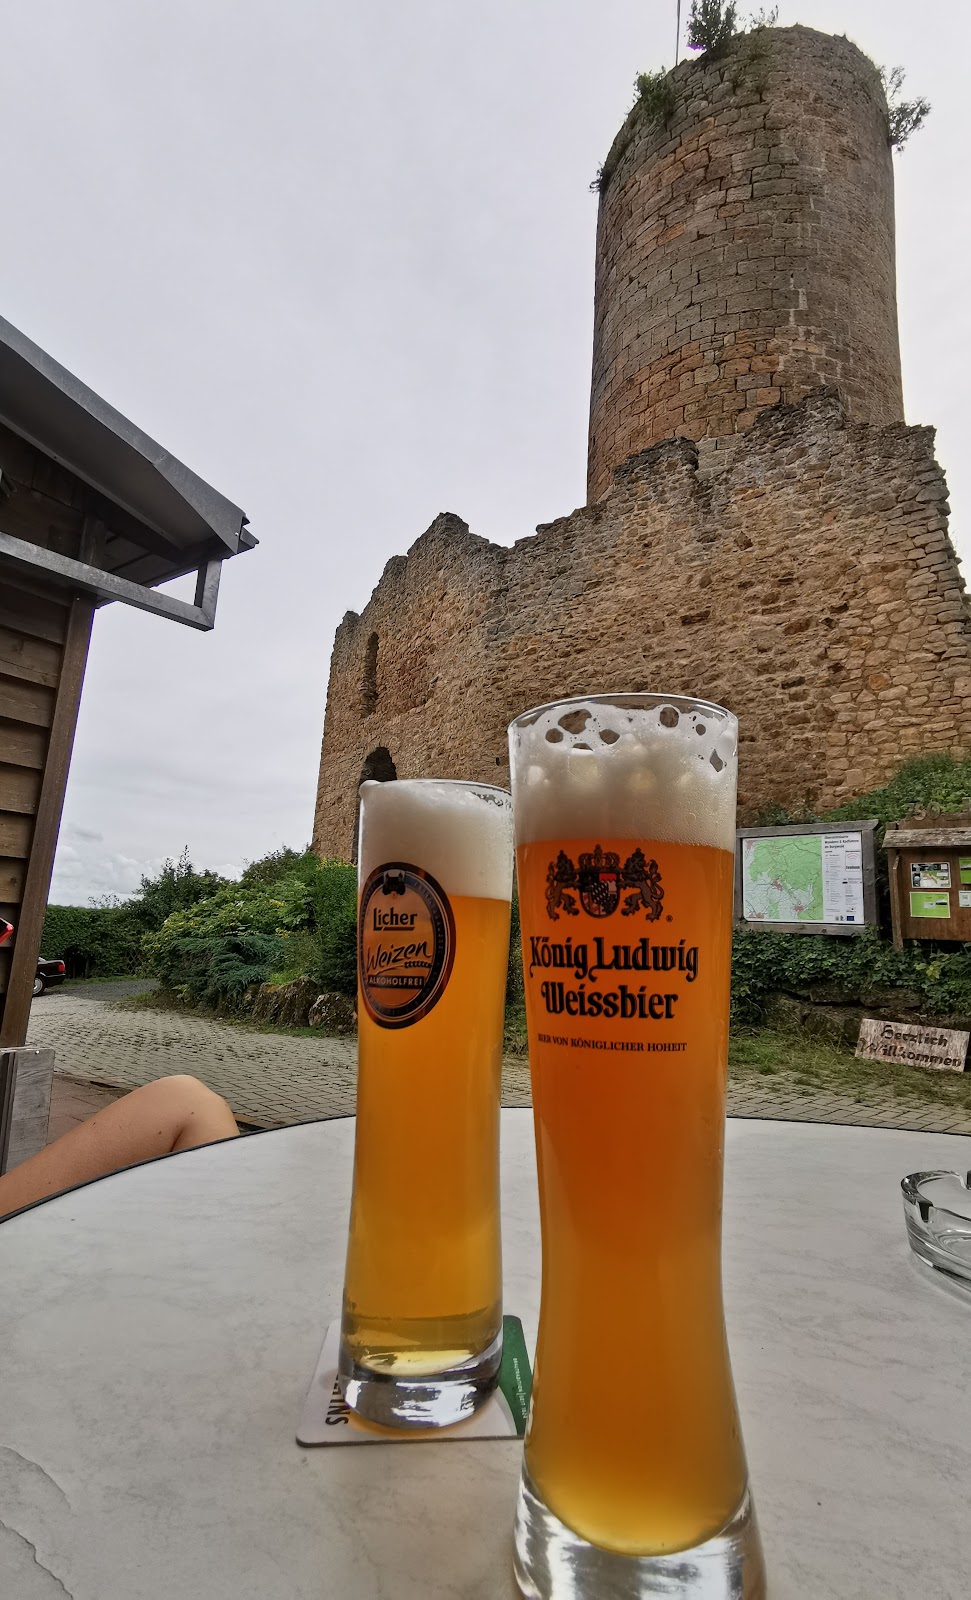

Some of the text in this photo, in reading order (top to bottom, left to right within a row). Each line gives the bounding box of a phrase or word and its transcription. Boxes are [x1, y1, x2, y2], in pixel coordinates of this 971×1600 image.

[373, 907, 417, 931] Licher
[366, 941, 432, 973] Weizen
[530, 936, 699, 982] König Ludwig
[370, 976, 422, 986] ALKOHOLFREI
[541, 981, 678, 1019] Weissbier
[551, 1036, 569, 1046] VON
[571, 1038, 644, 1051] KÖNIGLICHER
[647, 1042, 687, 1051] HOHEIT
